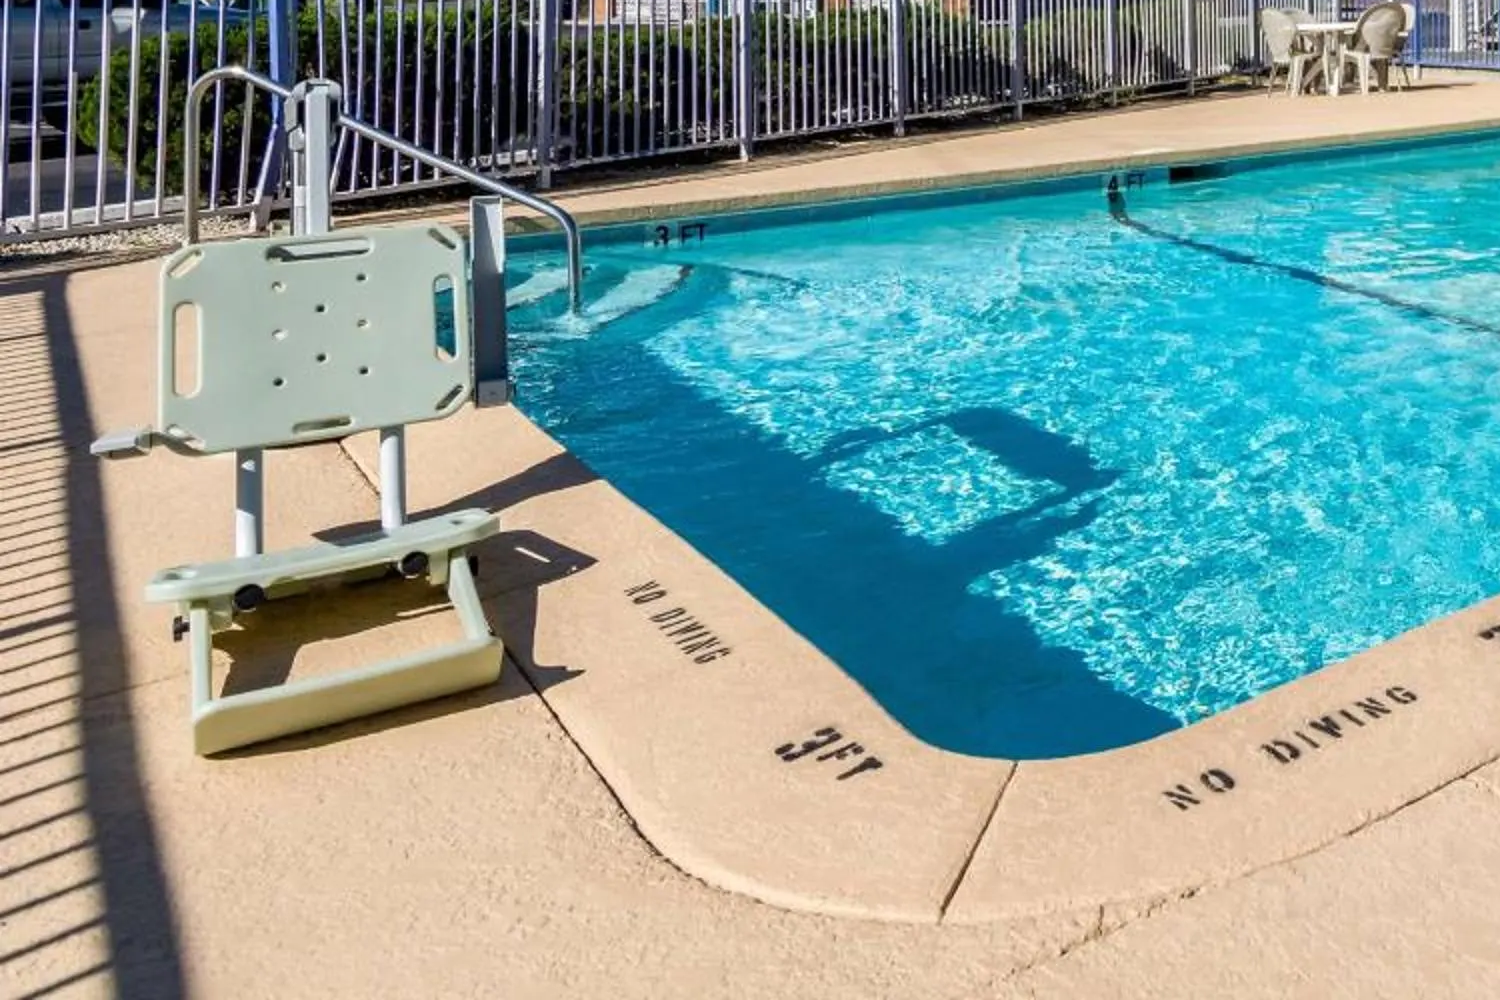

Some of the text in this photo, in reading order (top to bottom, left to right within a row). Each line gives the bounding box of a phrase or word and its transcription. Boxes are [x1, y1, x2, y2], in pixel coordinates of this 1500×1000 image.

[655, 223, 707, 247] 3 FT
[624, 579, 732, 664] NO DIVING
[1163, 686, 1419, 812] NO DIVING
